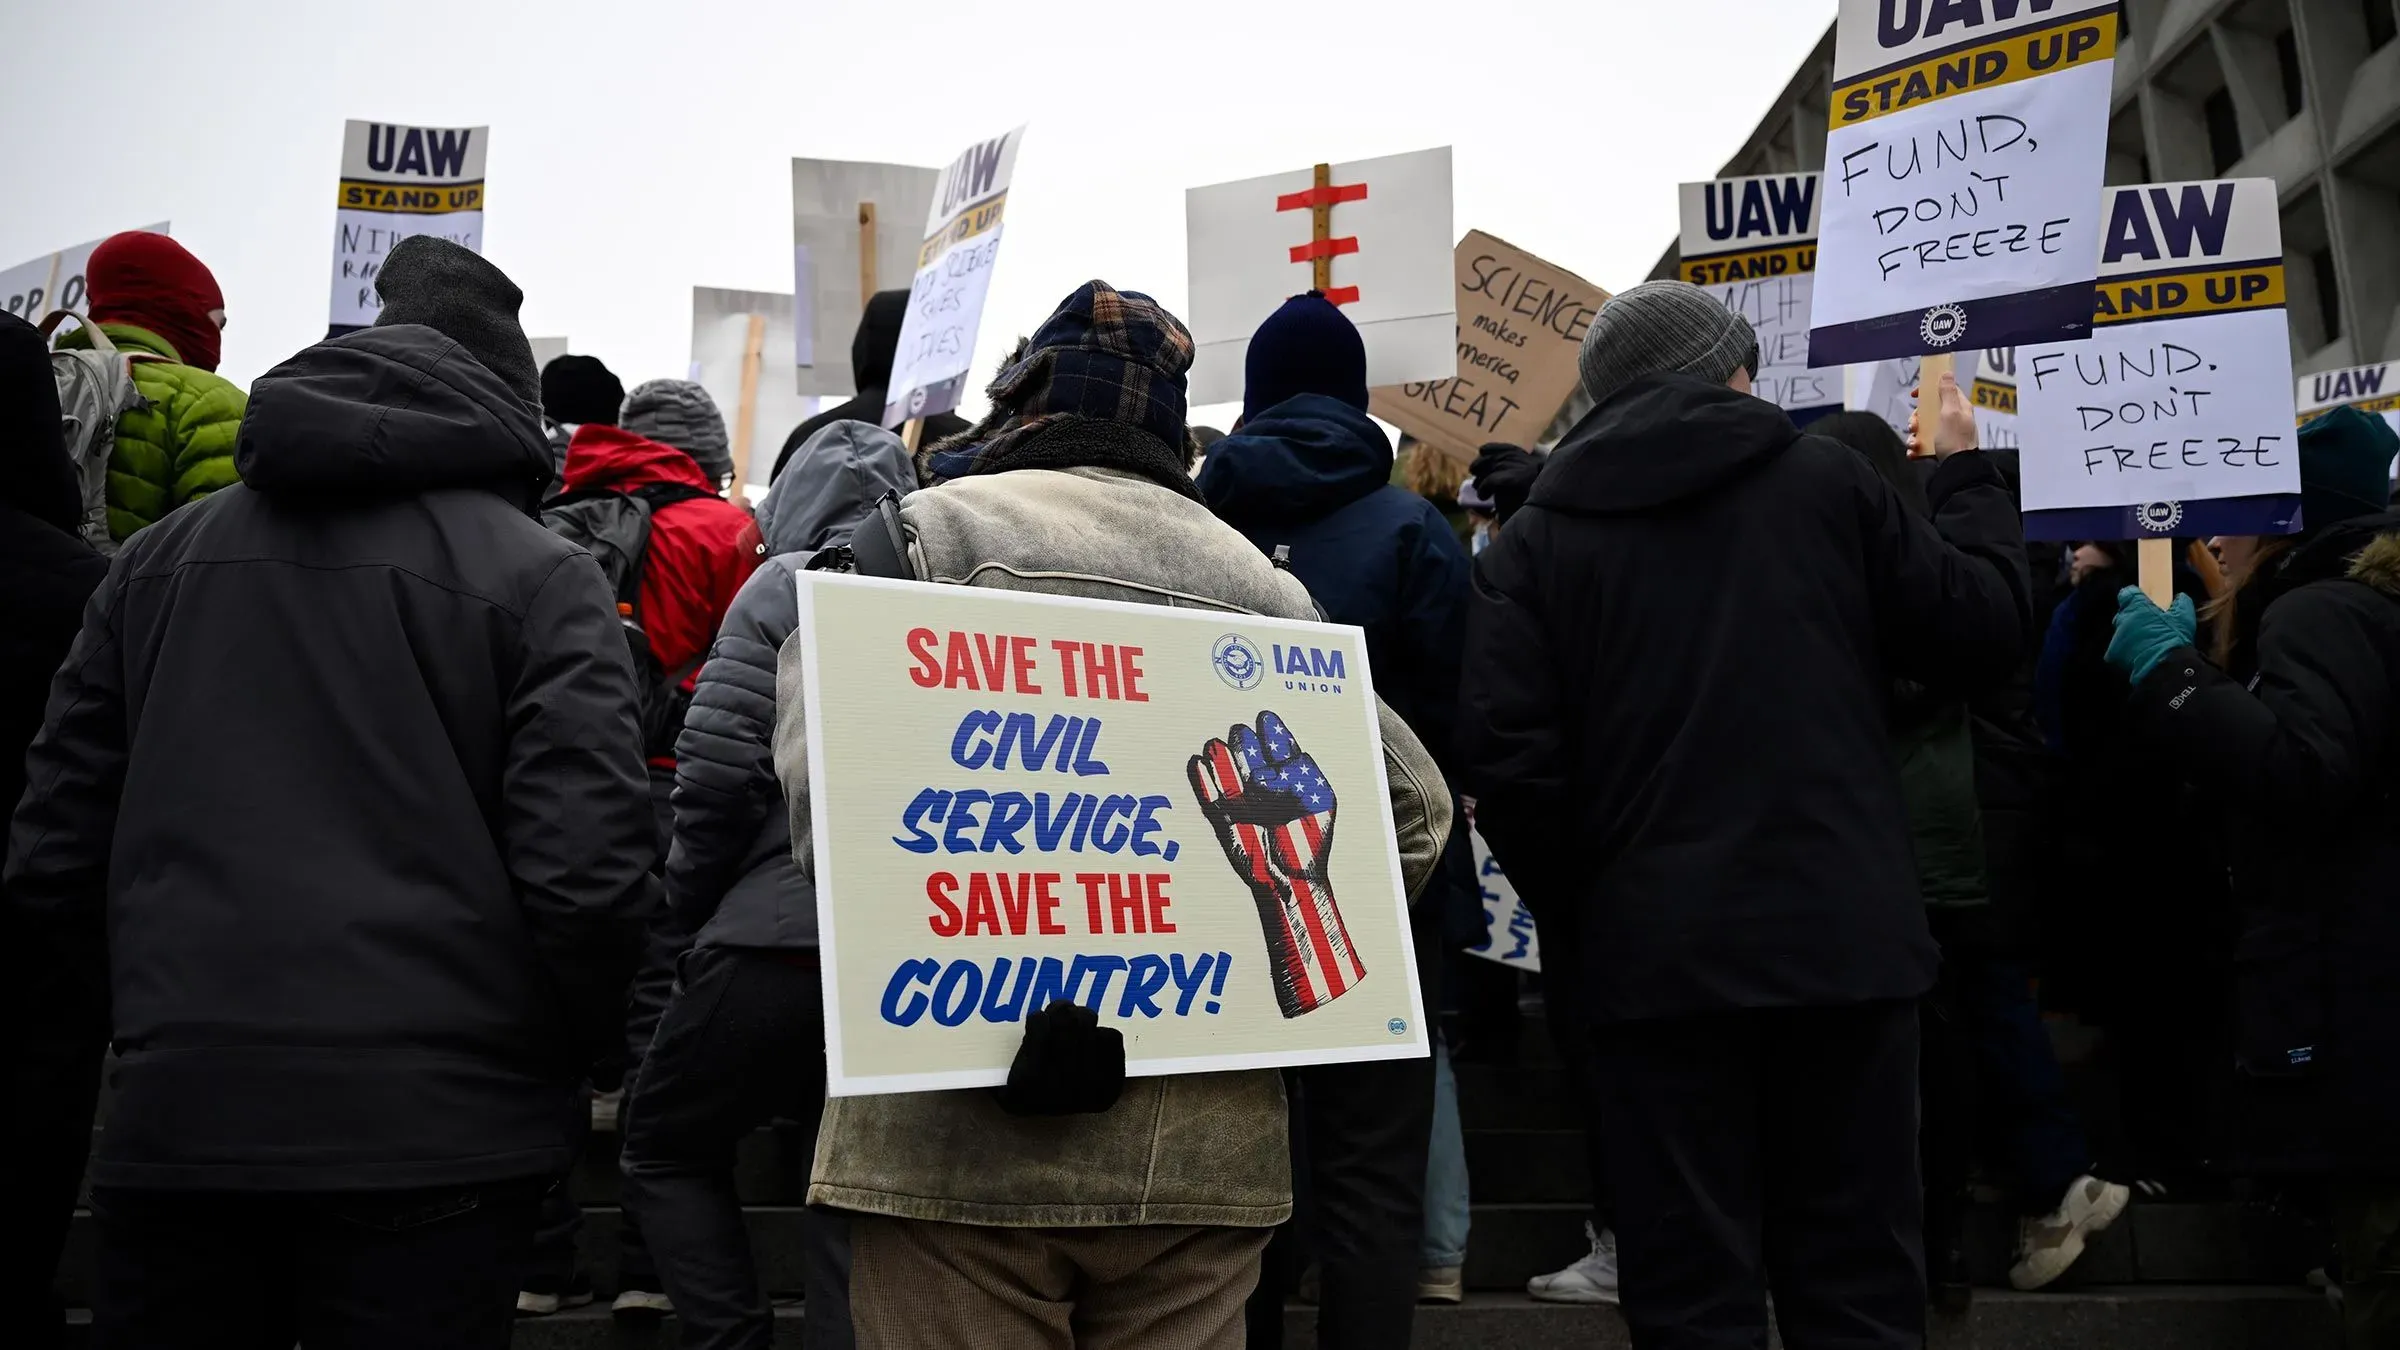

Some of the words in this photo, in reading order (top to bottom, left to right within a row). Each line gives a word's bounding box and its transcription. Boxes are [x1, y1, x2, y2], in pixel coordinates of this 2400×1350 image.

[1877, 0, 2055, 48] UA
[1842, 51, 2008, 121] STAND
[2027, 26, 2100, 71] UP
[367, 124, 471, 177] UAW
[941, 131, 1011, 218] UAW
[1842, 115, 2037, 197] FUND,
[346, 187, 440, 209] STAND
[448, 190, 479, 208] UP
[1705, 176, 1816, 241] UAW
[1873, 172, 2010, 235] DON'T
[2101, 183, 2236, 264] AW
[1690, 254, 1788, 286] STAND
[1797, 251, 1815, 271] U
[1878, 218, 2070, 281] FREEZE
[1461, 255, 1597, 342] SCIENCE
[2093, 283, 2188, 316] AND
[2205, 274, 2270, 304] UP
[1472, 314, 1529, 348] makes
[1933, 319, 1953, 330] UAW
[1456, 325, 1520, 385] merica
[2032, 343, 2218, 391] FUND.
[1752, 376, 1826, 405] IVES
[1977, 386, 2017, 412] STA
[2315, 366, 2387, 402] UAW
[2077, 387, 2212, 431] DON'T
[1987, 422, 2019, 450] NI
[2084, 436, 2282, 476] FREEZE
[2149, 507, 2170, 517] UAW
[906, 627, 1042, 695] SAVE
[1051, 640, 1149, 702] THE
[1272, 644, 1346, 679] IAM
[1285, 680, 1342, 694] UNION
[951, 709, 1110, 777] CIVIL
[892, 787, 1180, 862] SERVICE,
[926, 871, 1066, 938] SAVE
[1076, 873, 1177, 934] THE
[879, 951, 1232, 1028] COUNTRY!
